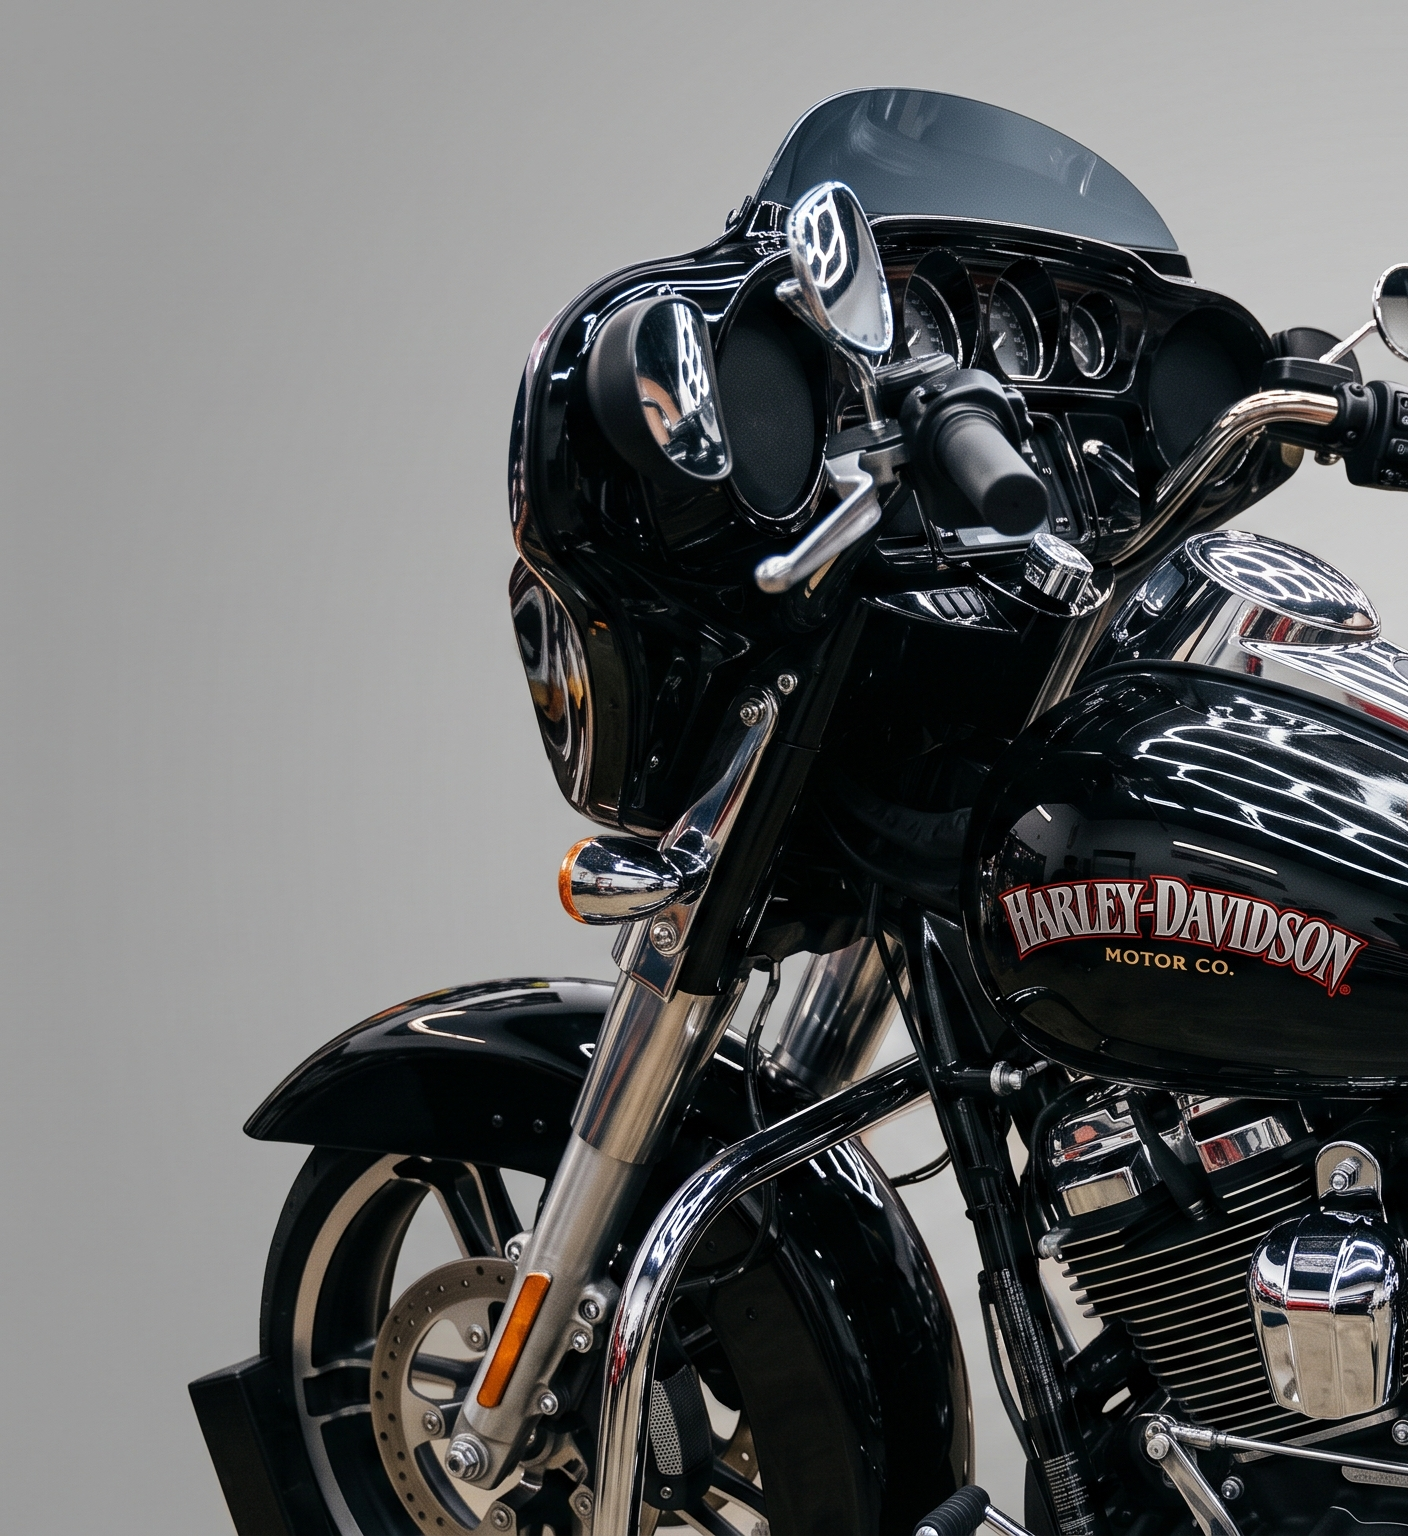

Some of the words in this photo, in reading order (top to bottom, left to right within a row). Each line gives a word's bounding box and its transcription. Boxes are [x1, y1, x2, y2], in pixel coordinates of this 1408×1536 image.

[1001, 877, 1366, 994] HARLEY-DAVIDSON
[1105, 947, 1187, 971] MOTOR
[1195, 958, 1235, 976] CO.
